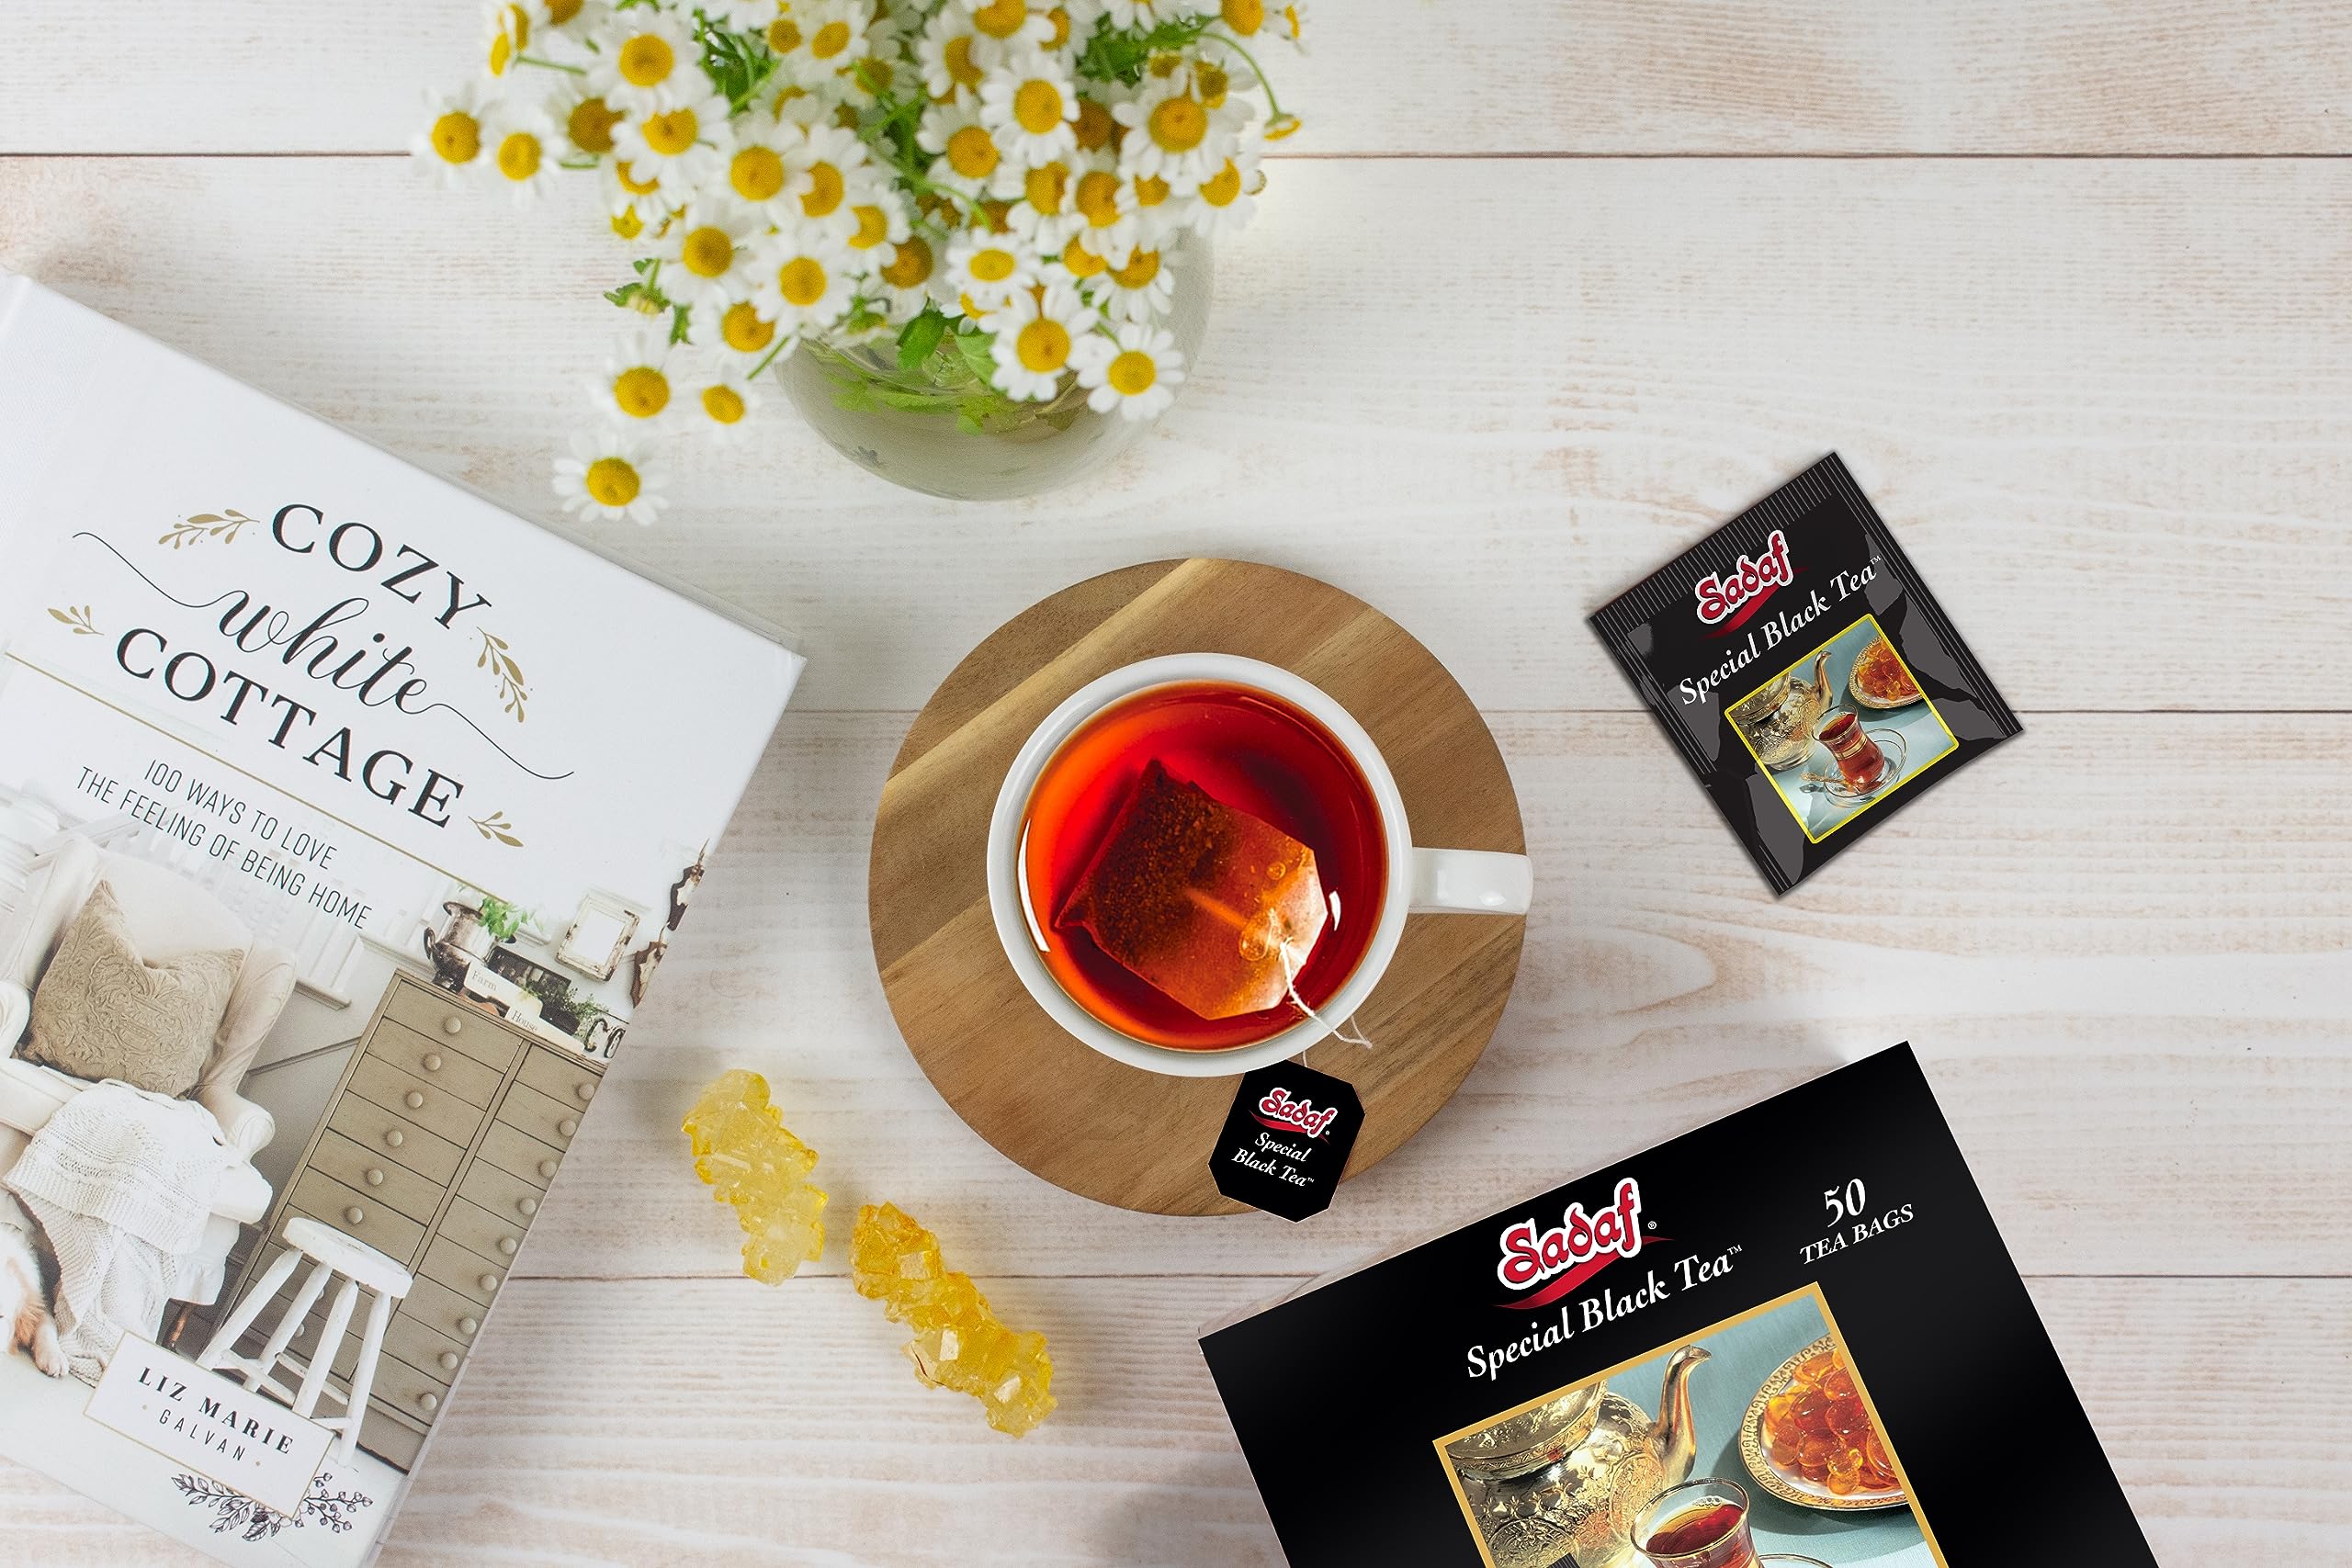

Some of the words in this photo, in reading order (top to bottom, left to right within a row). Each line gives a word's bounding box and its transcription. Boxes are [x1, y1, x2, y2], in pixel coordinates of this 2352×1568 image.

[272, 503, 492, 630] COZY
[1695, 530, 1793, 625] Sadaf
[218, 589, 428, 716] white
[1679, 633, 1761, 705] Special
[1759, 589, 1831, 650] Black
[116, 627, 465, 829] COTTAGE
[76, 766, 119, 805] THE
[119, 789, 206, 847] FEELING
[209, 833, 241, 862] OF
[241, 850, 306, 897] BEING
[308, 882, 372, 930] HOME
[144, 760, 183, 793] 100
[187, 779, 246, 825] WAYS
[249, 810, 278, 840] TO
[280, 827, 337, 870] LOVE
[471, 970, 498, 992] Farm
[512, 1010, 538, 1032] House
[1231, 1147, 1277, 1176] Black
[1255, 1132, 1312, 1163] Special
[1799, 1232, 1849, 1265] TEA
[1851, 1203, 1914, 1245] BAGS
[1824, 1178, 1866, 1228] 50
[1467, 1306, 1575, 1381] Special
[1578, 1270, 1670, 1333] Black
[138, 1367, 187, 1402] LIZ
[198, 1396, 293, 1454] MARIE
[159, 1409, 245, 1461] GALVAN
